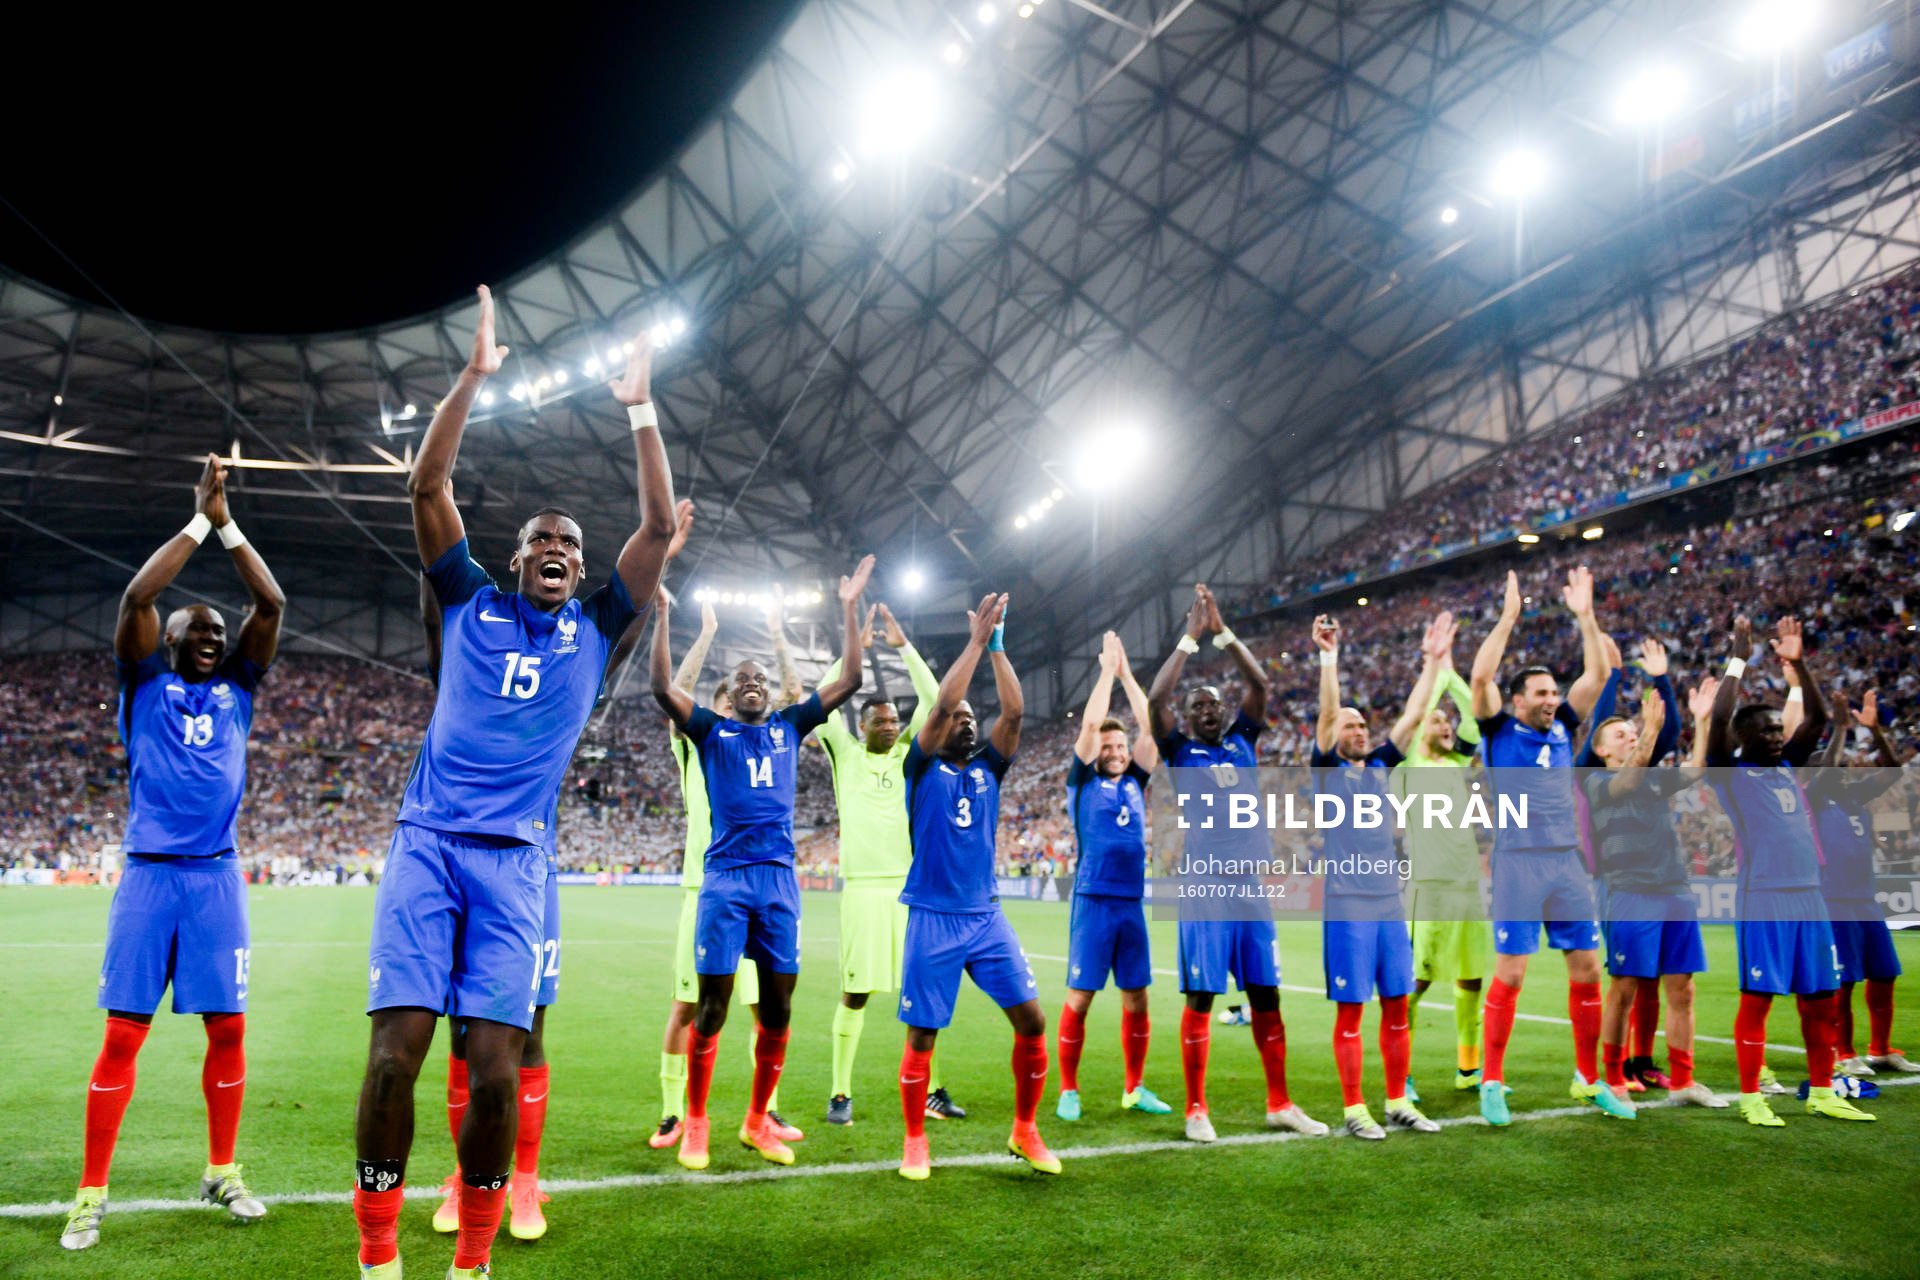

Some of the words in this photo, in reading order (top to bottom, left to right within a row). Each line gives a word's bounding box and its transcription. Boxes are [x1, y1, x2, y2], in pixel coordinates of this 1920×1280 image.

[501, 652, 541, 700] 15
[182, 713, 214, 747] 13
[746, 756, 775, 788] 14
[1535, 744, 1552, 772] 4
[871, 770, 894, 790] 16
[955, 797, 973, 828] 3
